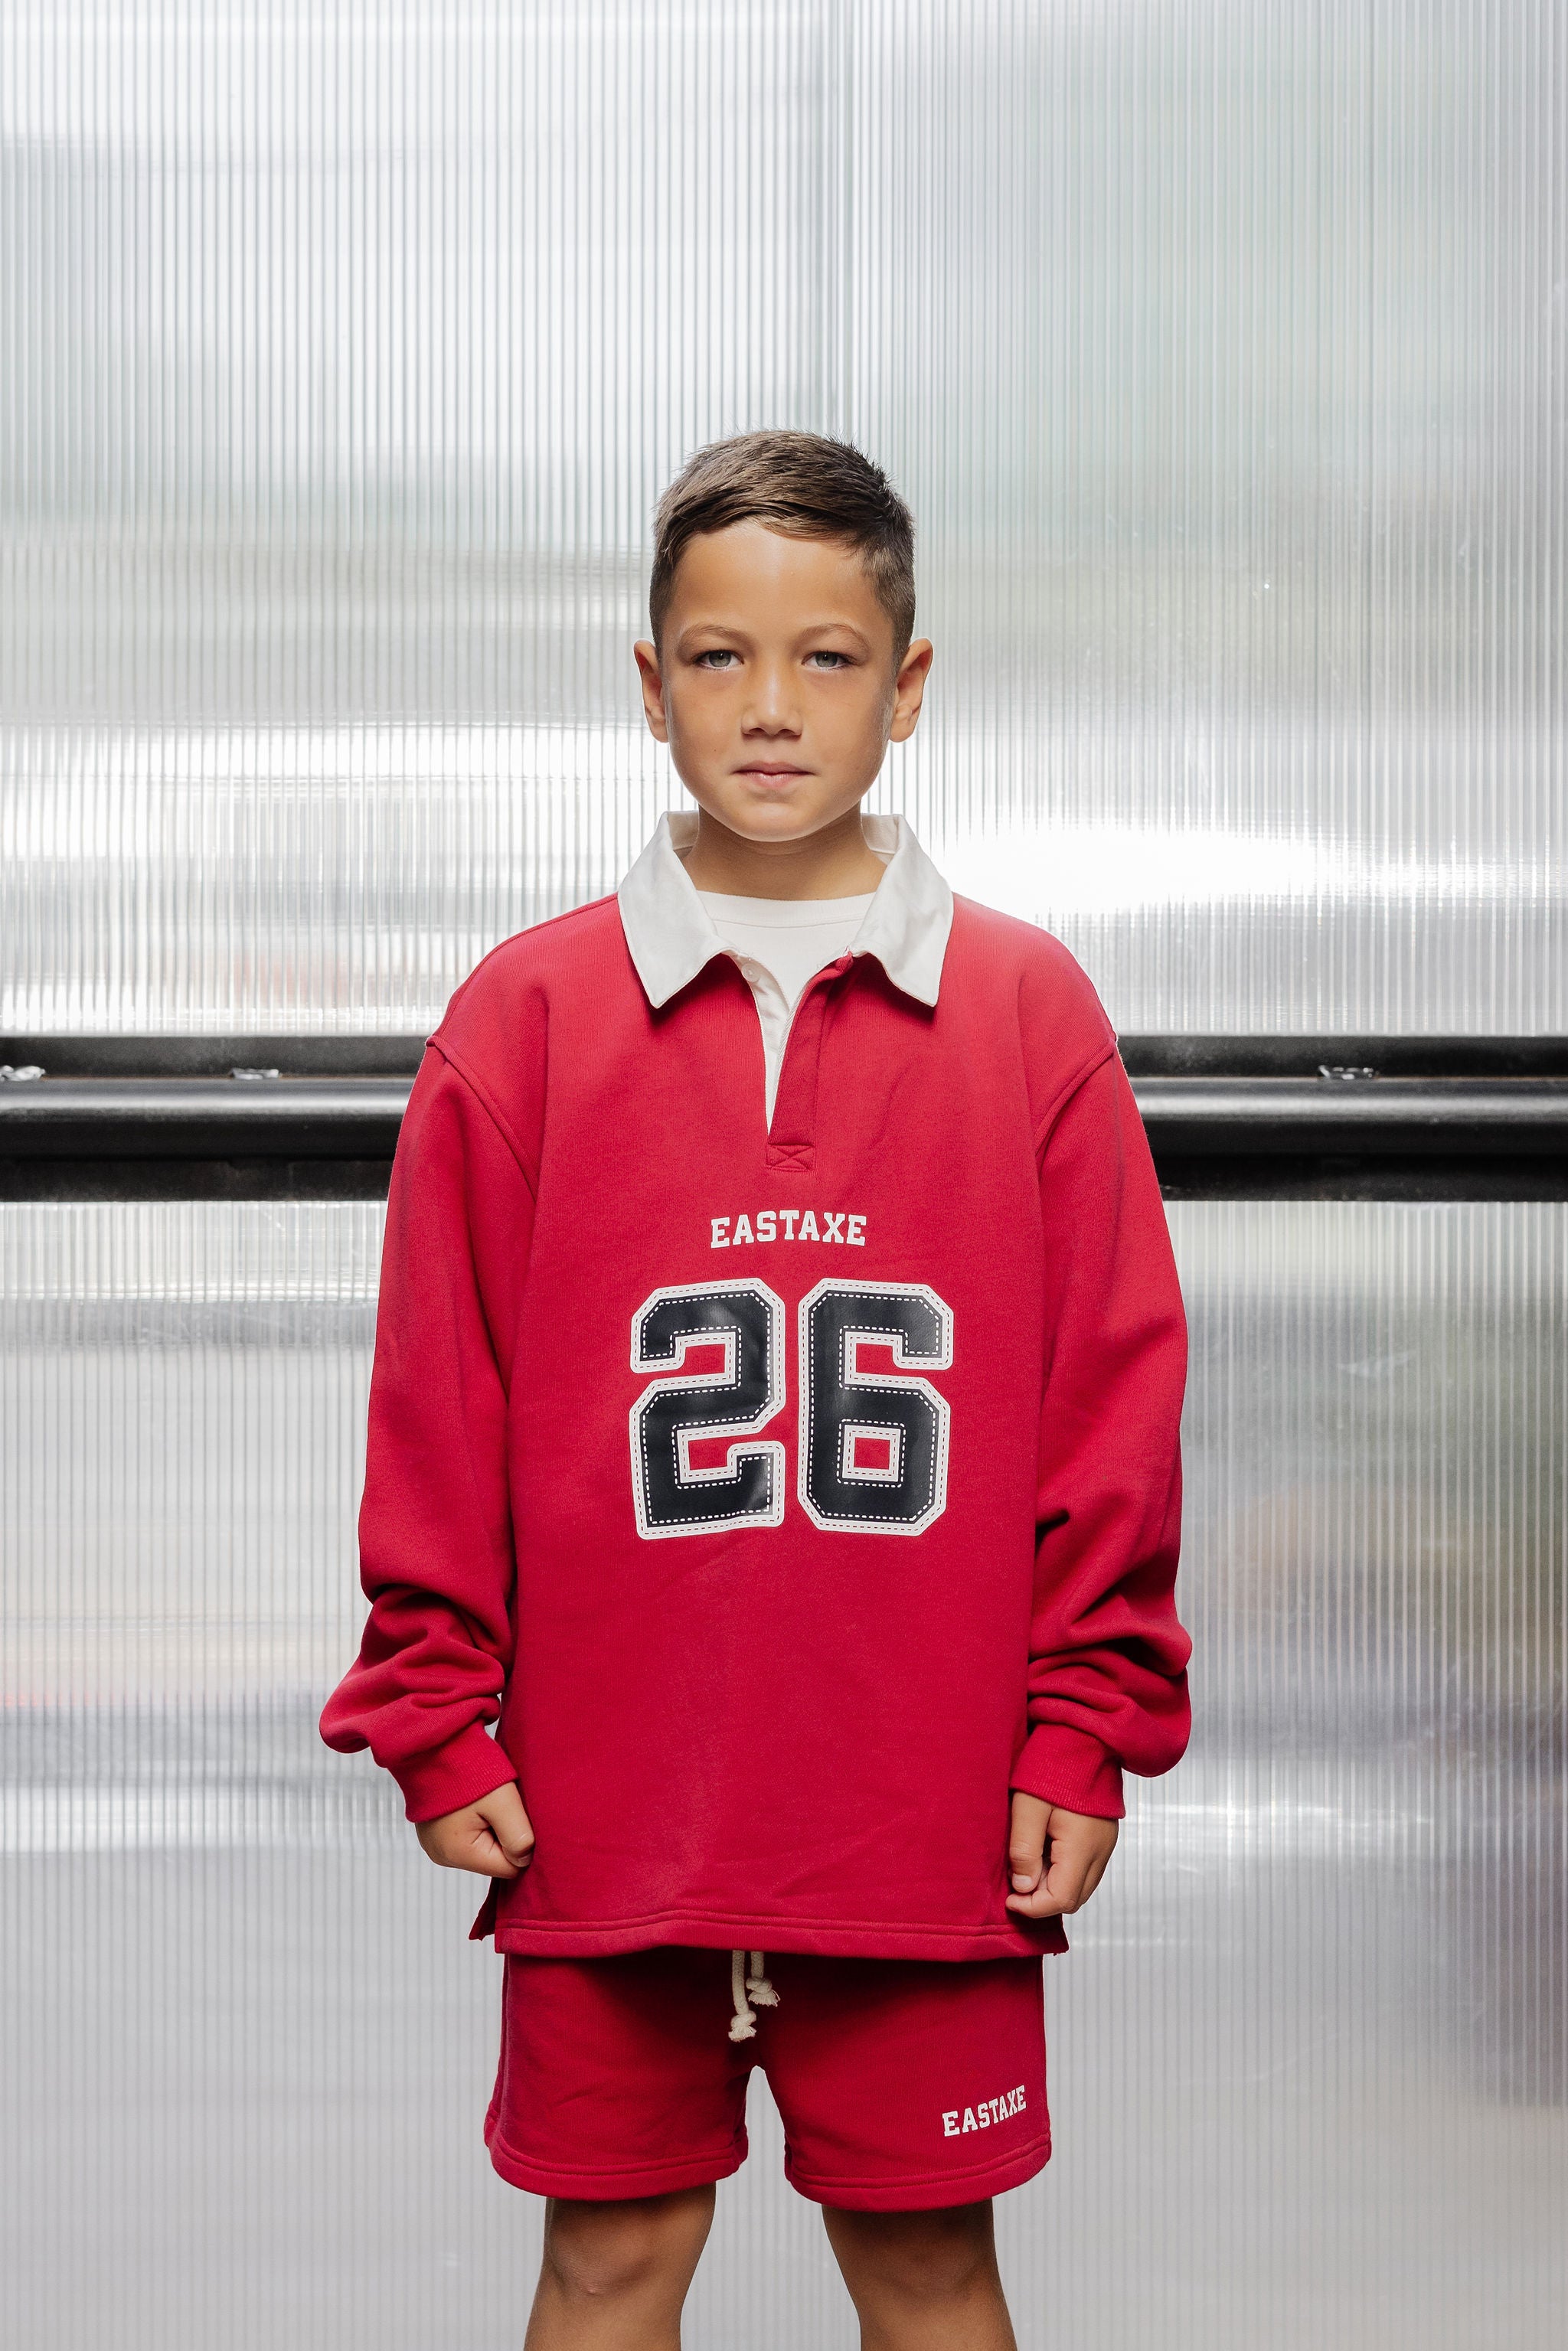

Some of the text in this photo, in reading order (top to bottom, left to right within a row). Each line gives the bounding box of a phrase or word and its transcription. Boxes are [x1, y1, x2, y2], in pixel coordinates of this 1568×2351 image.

[710, 1210, 867, 1249] EASTAXE
[629, 1277, 954, 1540] 26
[942, 2085, 1027, 2137] EASTAXE
